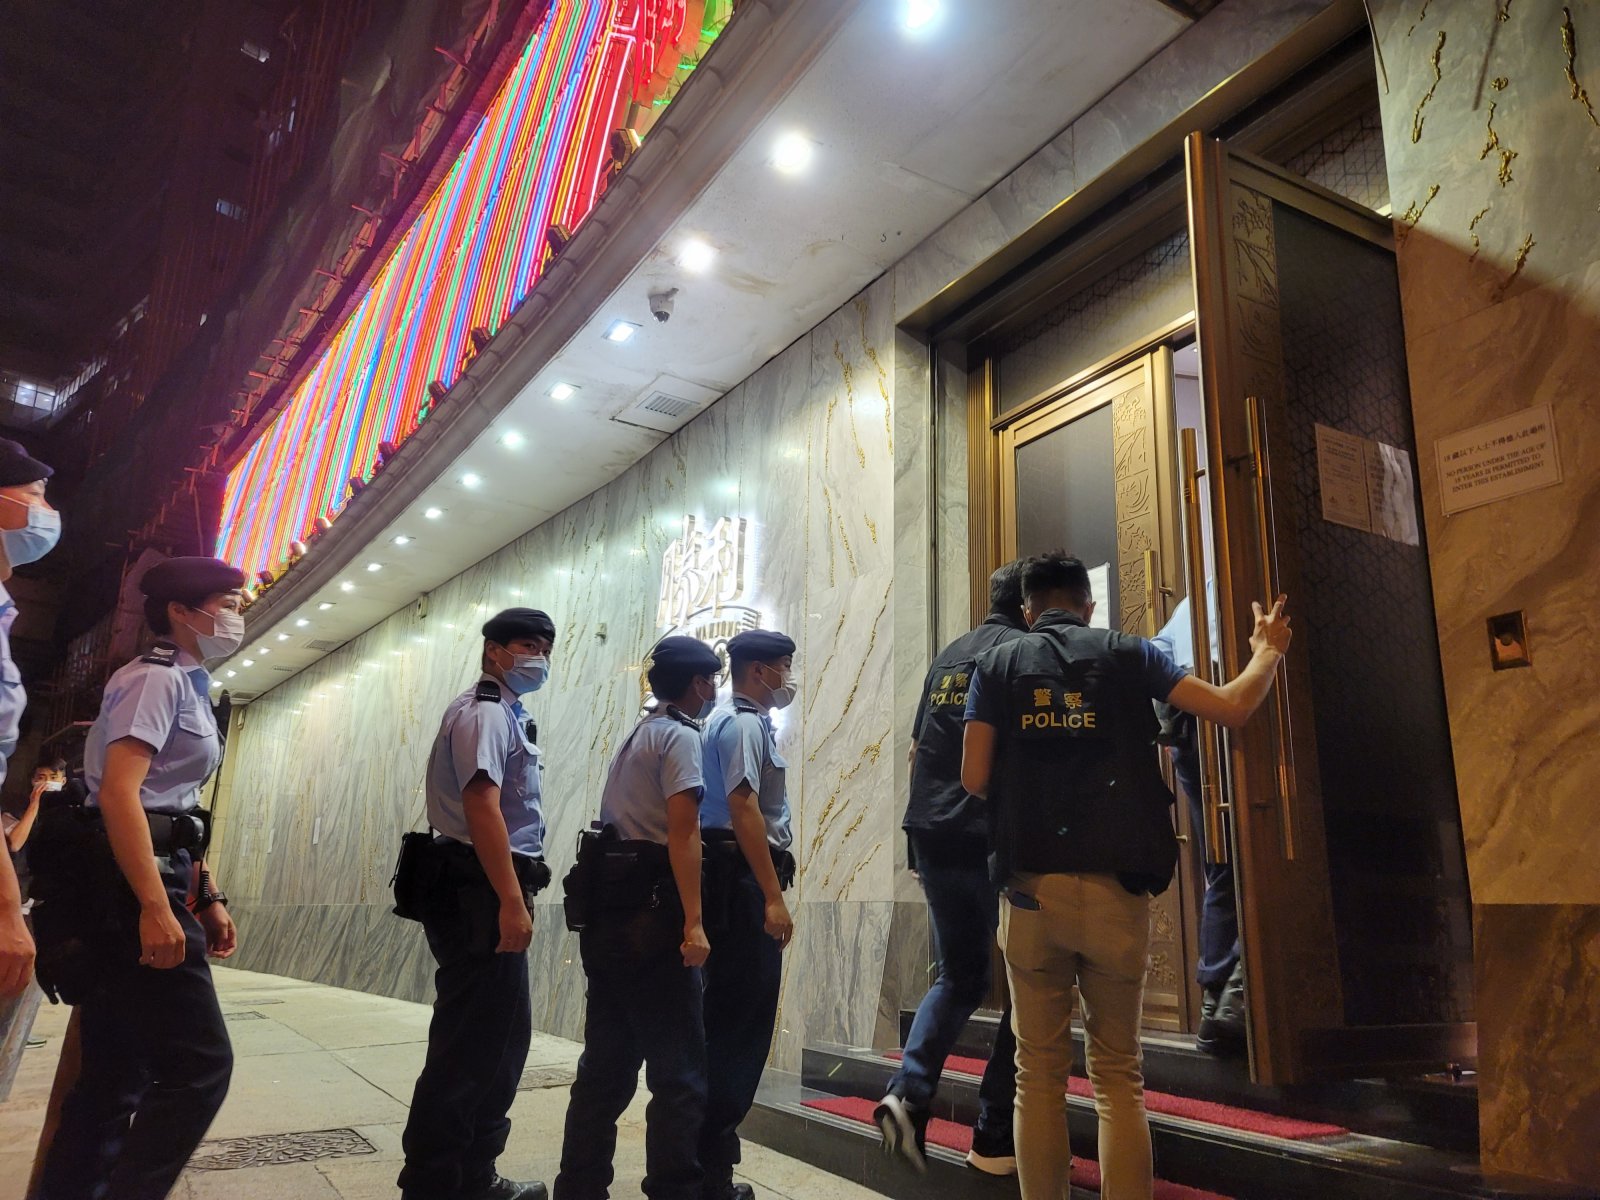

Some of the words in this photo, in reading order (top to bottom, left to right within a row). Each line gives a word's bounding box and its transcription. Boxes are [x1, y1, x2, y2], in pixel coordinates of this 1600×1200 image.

[1446, 469, 1456, 478] NO
[1456, 461, 1481, 475] PERSON
[1482, 454, 1505, 468] UNDER
[1506, 449, 1520, 461] THE
[1520, 445, 1535, 456] AGE
[1535, 441, 1546, 451] OF
[1462, 469, 1484, 482] YEARS
[1492, 455, 1530, 473] PERMITTED
[1531, 452, 1541, 461] TO
[1452, 481, 1473, 493] ENTER
[1474, 476, 1489, 487] THIS
[1490, 460, 1544, 482] ESTABLISHMENT
[1033, 687, 1083, 709] 警察
[1021, 712, 1096, 730] POLICE
